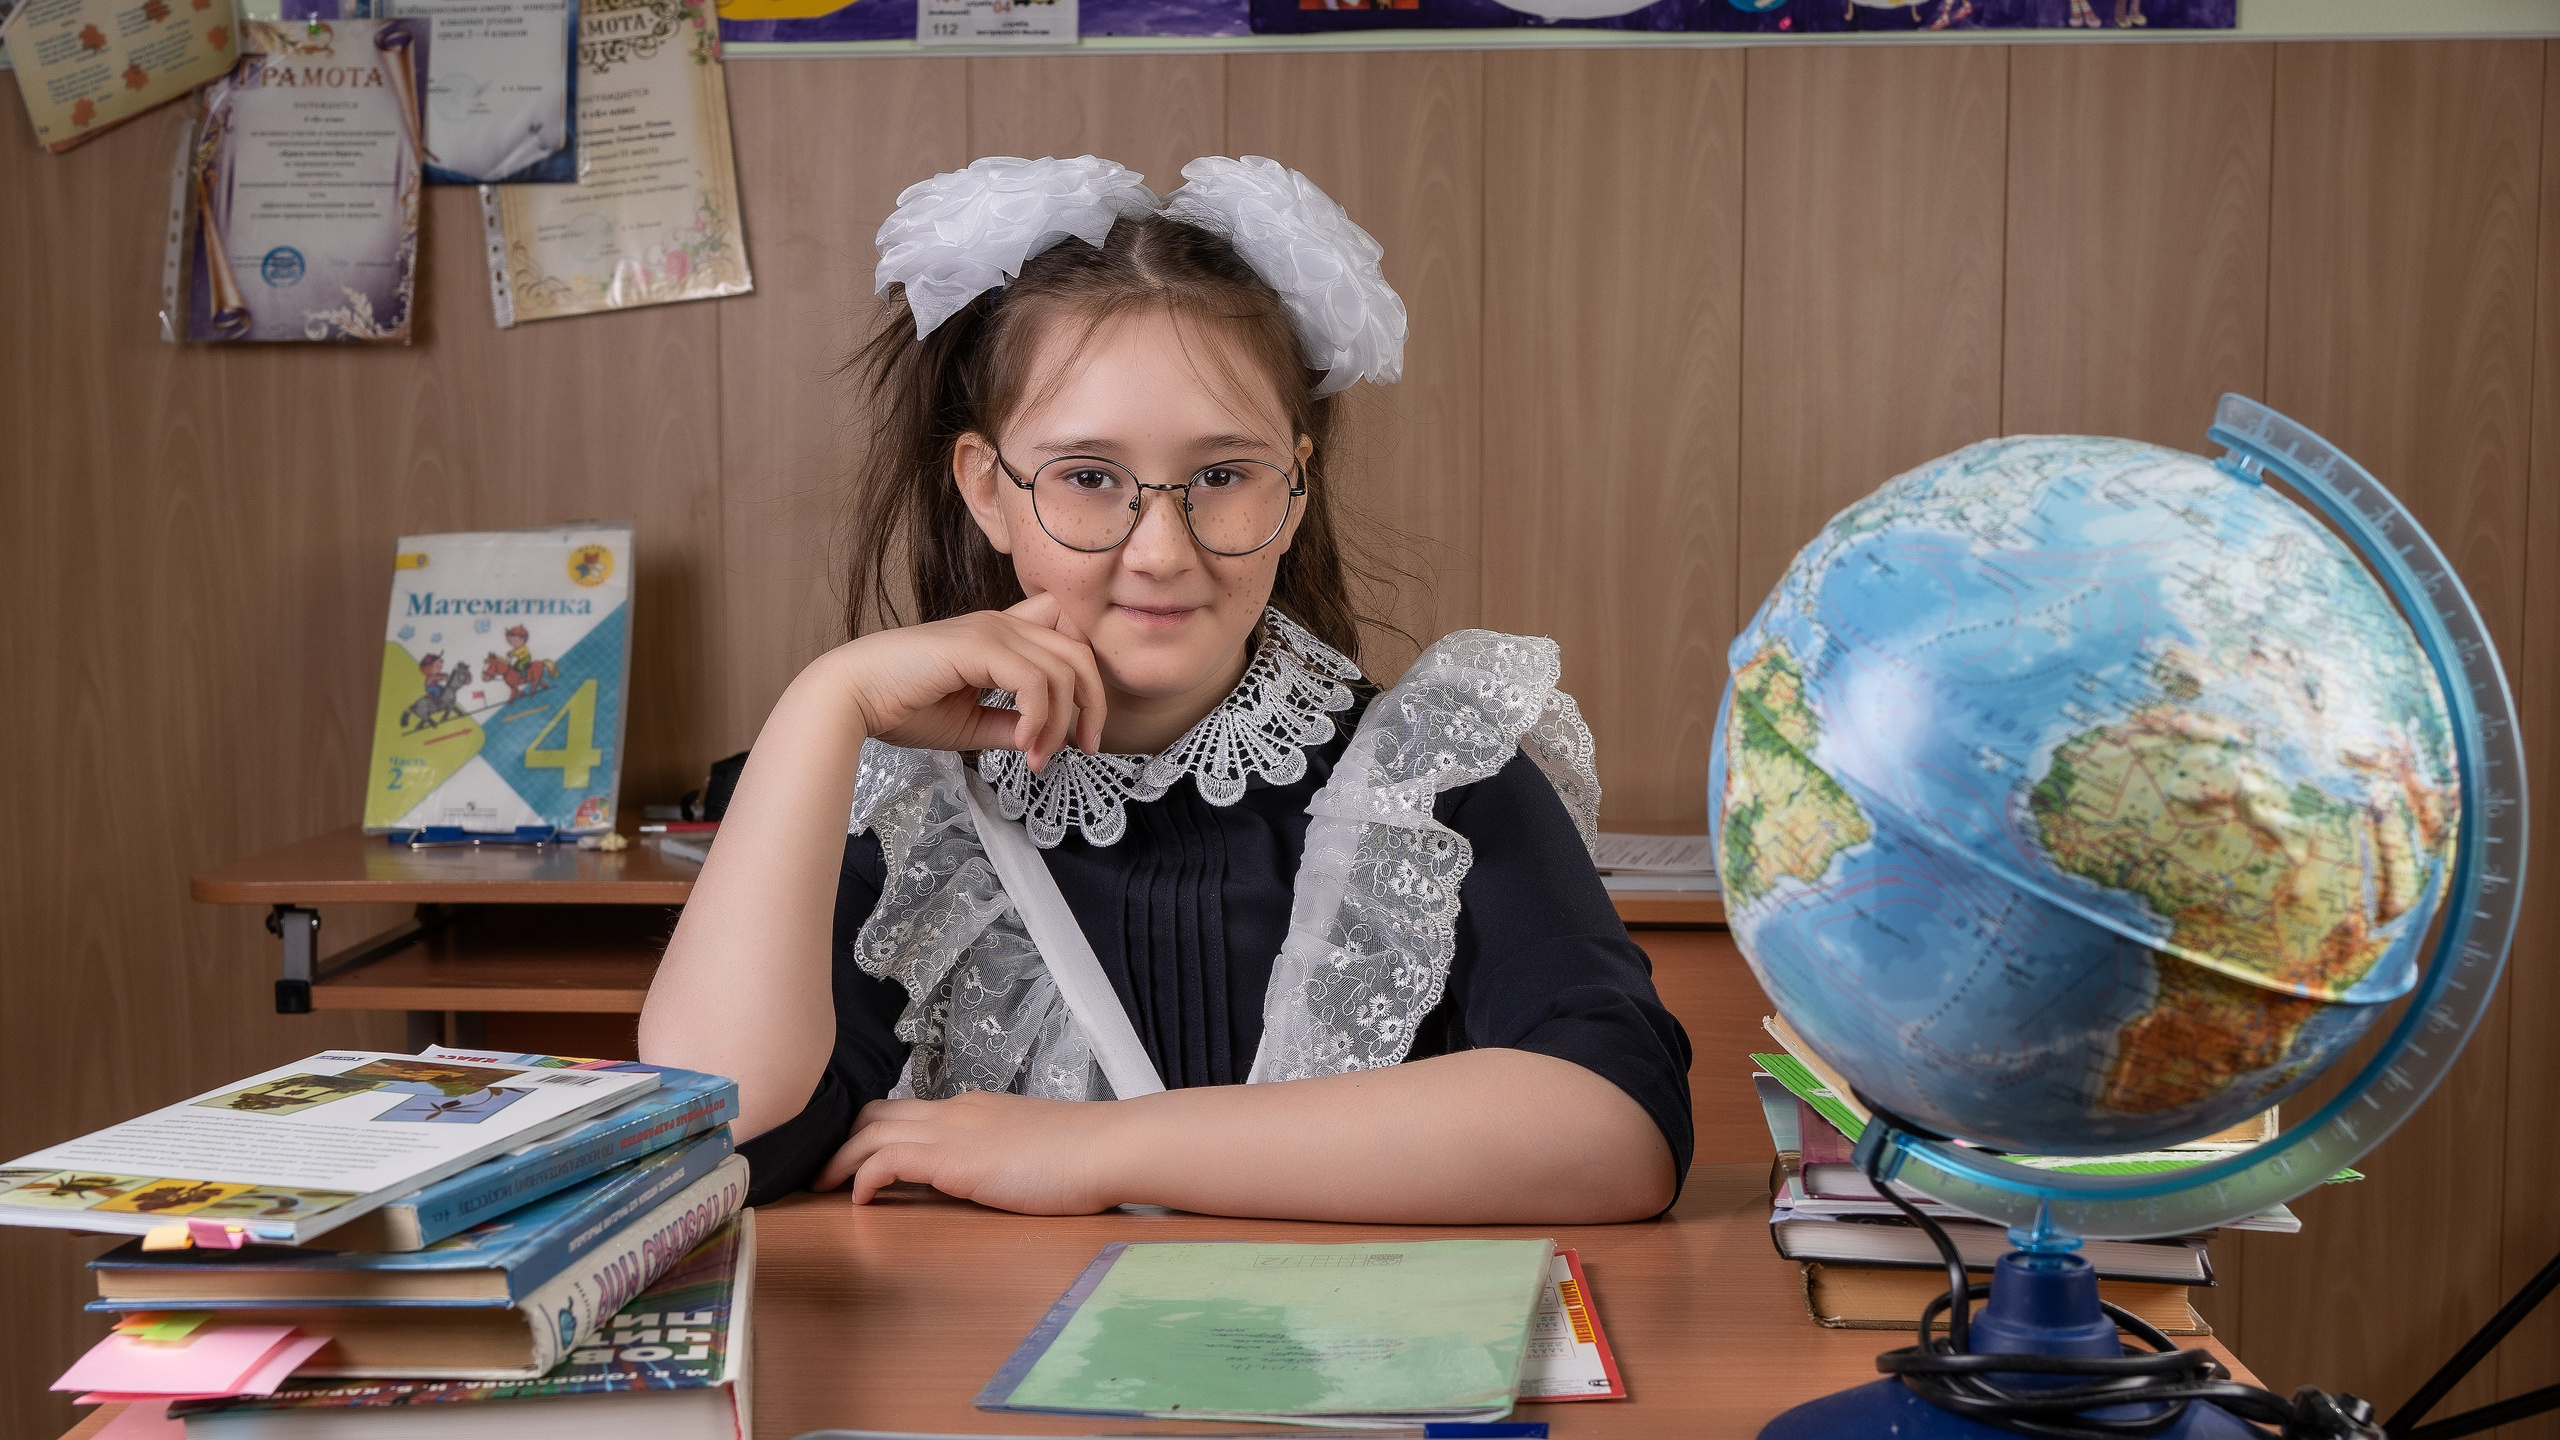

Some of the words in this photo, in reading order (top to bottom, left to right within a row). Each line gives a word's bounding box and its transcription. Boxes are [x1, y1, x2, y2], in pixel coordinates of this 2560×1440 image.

[932, 22, 959, 36] 112
[238, 55, 385, 89] ГРАМОТА
[406, 591, 592, 617] Математика
[524, 678, 602, 789] 4
[387, 755, 427, 767] Часть
[387, 768, 404, 791] 2
[436, 1053, 500, 1064] КЛАСС
[619, 1117, 675, 1150] РАЗРАБОТКИ
[593, 1250, 641, 1329] МИР
[601, 1311, 714, 1329] ПИ
